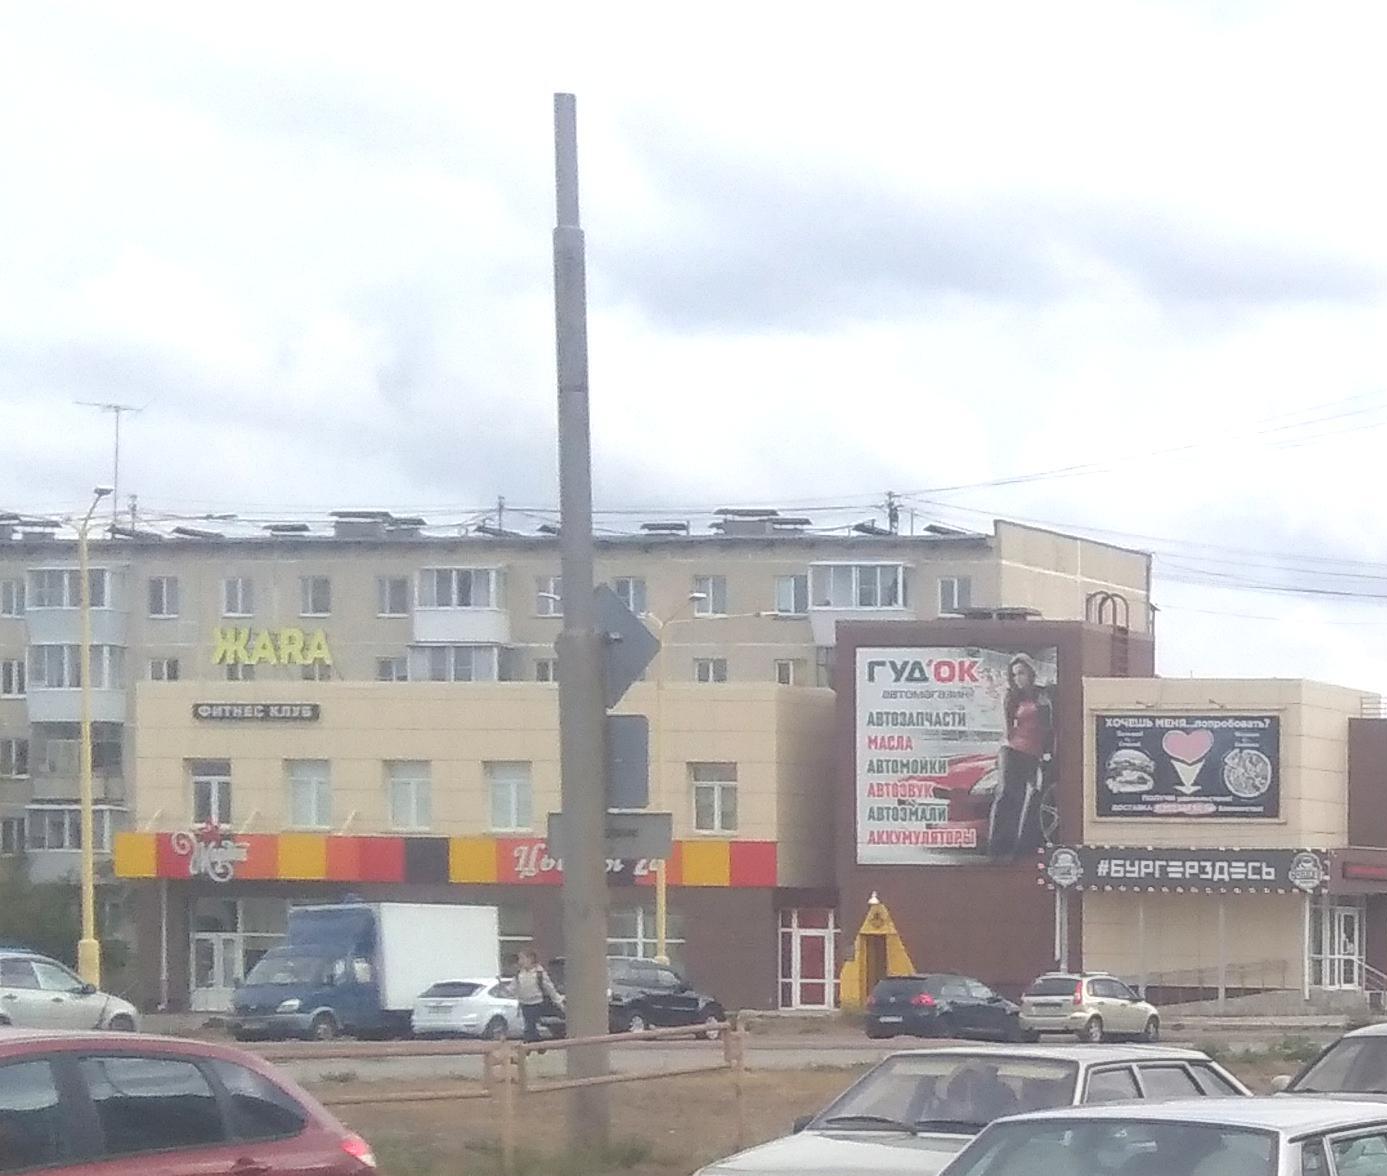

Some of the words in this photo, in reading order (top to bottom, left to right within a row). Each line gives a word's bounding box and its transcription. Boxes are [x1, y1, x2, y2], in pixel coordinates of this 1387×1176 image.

[198, 705, 265, 718] ФИТНЕС
[269, 705, 312, 718] КЛУБ
[867, 711, 966, 727] АВТОЗАПЧАСТИ
[867, 735, 913, 751] МАСЛА
[867, 756, 947, 774] АВТОМОЙКИ
[867, 782, 934, 798] АВТОЗВУК
[867, 829, 976, 846] АККУМУЛЯТОРЫ
[1097, 859, 1276, 881] #БУРГЕРЗДЕСЬ
